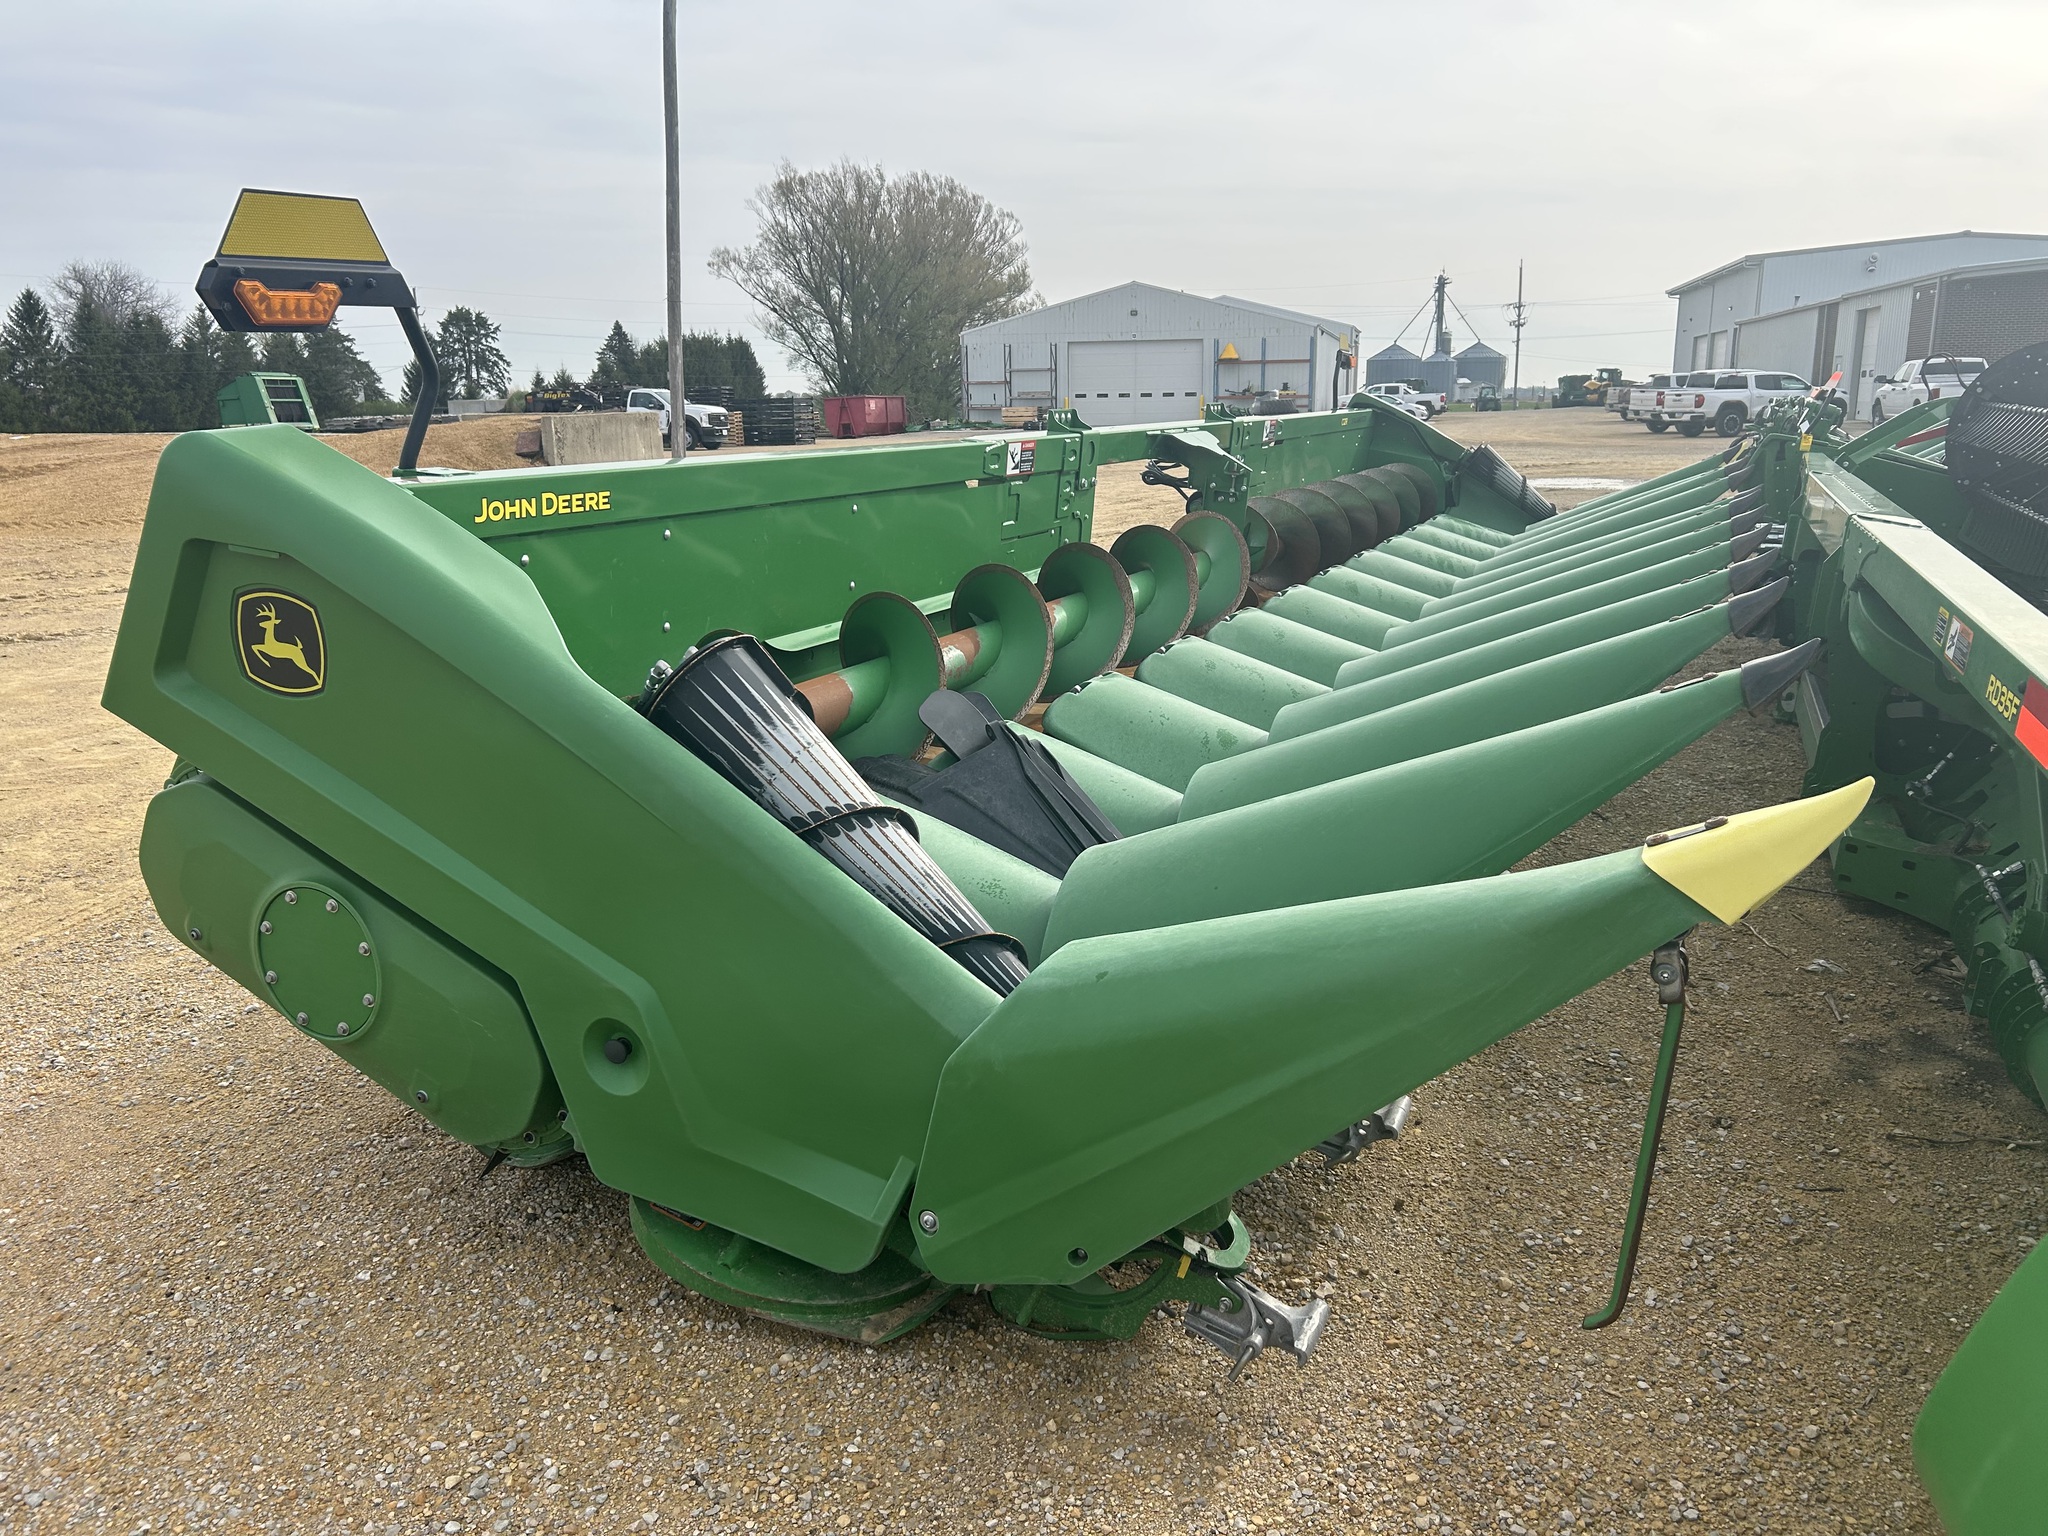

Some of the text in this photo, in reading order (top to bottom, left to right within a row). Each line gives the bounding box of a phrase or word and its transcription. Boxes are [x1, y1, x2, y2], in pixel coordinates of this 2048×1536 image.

[474, 491, 611, 524] JOHN DEERE
[1985, 673, 2021, 722] RD35F
